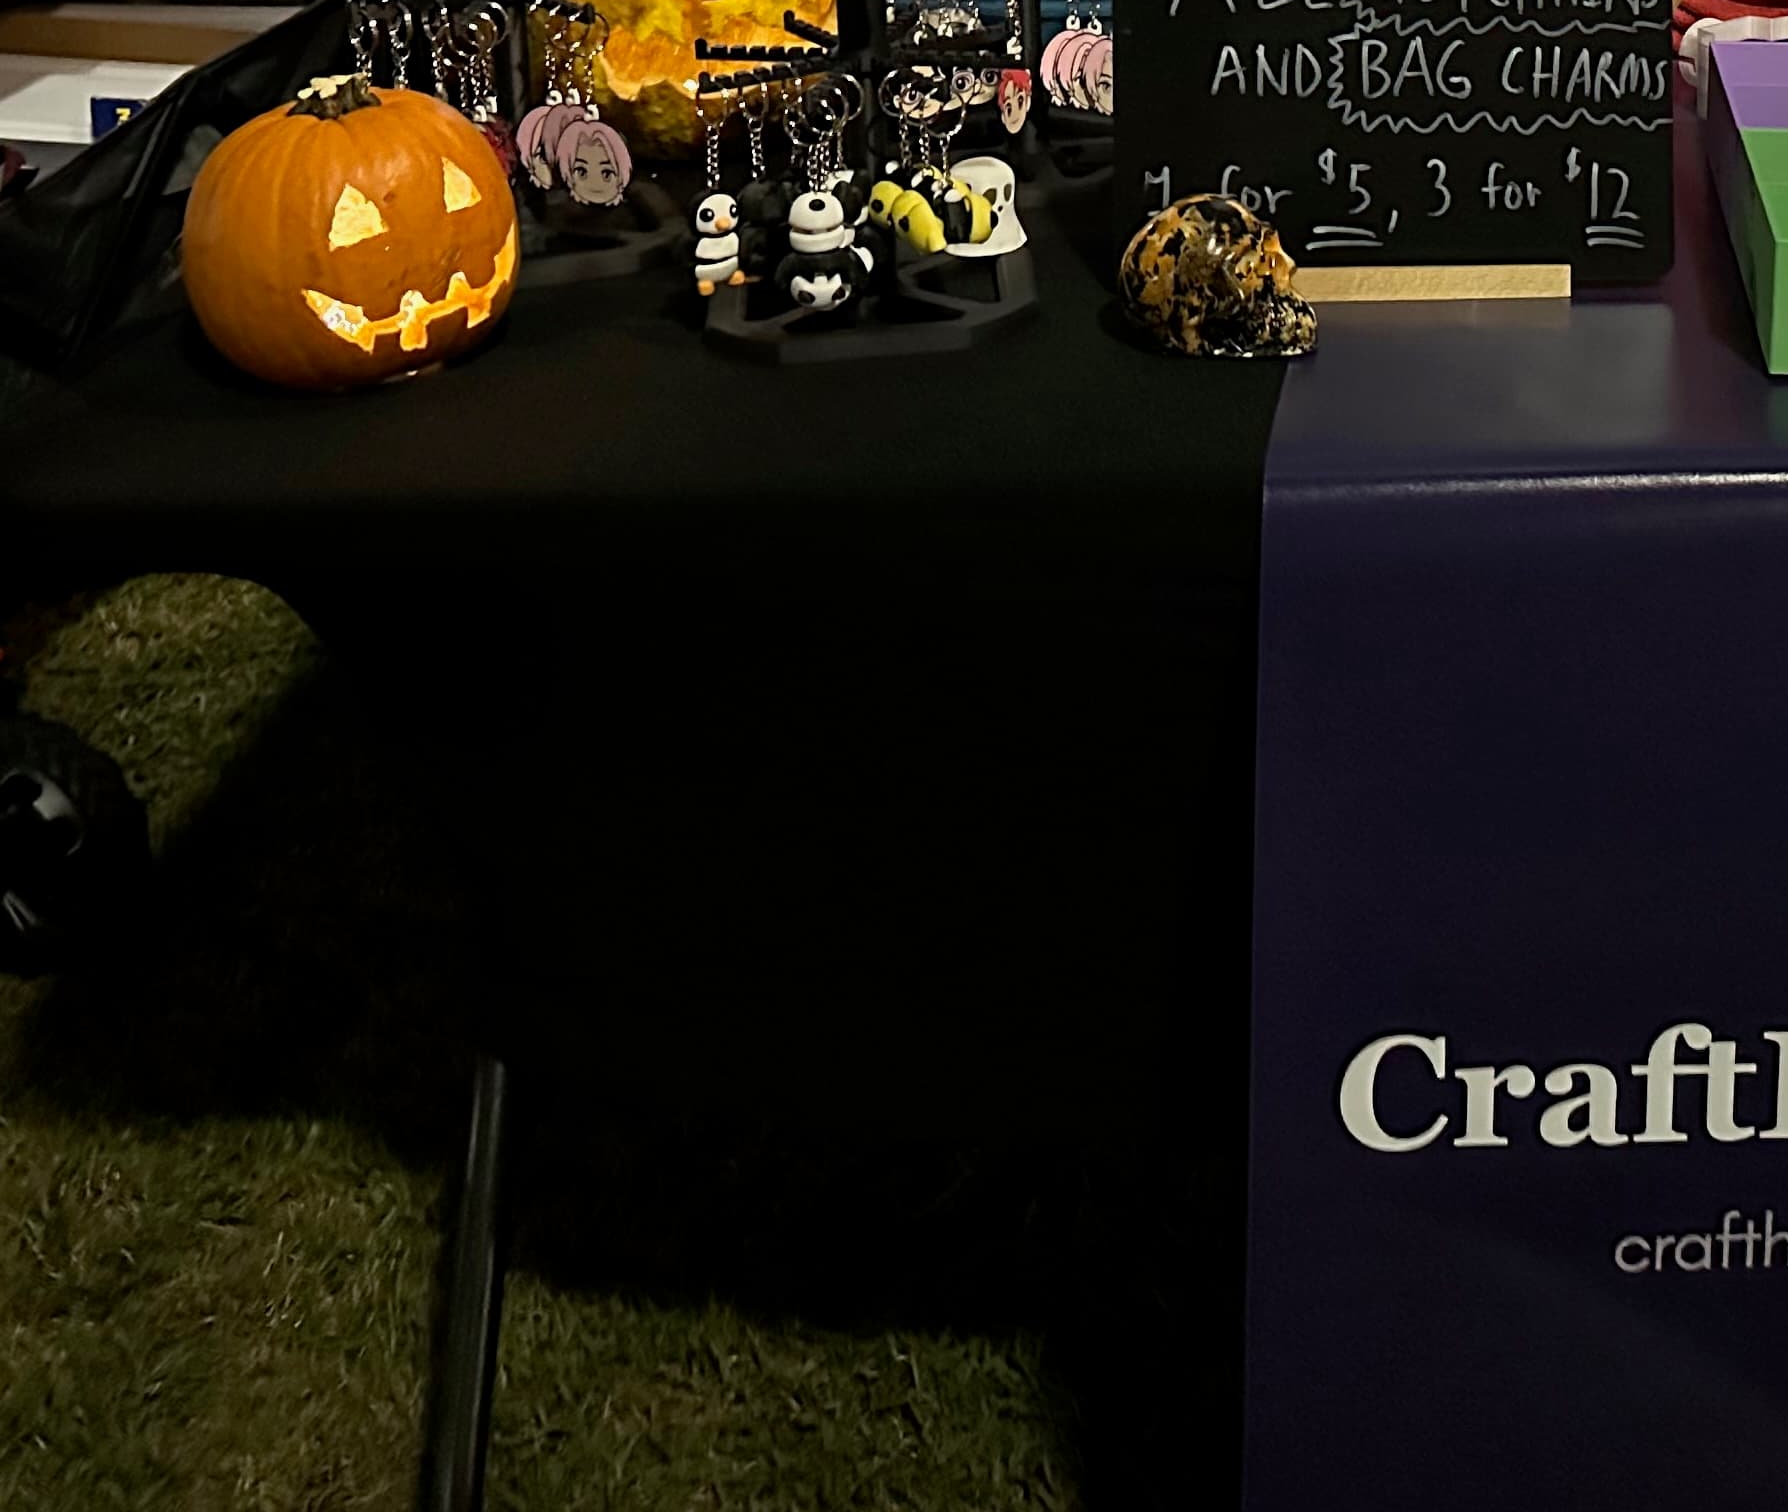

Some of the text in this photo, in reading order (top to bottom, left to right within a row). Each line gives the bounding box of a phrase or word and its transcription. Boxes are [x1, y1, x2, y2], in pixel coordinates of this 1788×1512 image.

[1211, 35, 1667, 101] AND BAG CHARMS
[1220, 164, 1293, 214] for
[1317, 147, 1398, 234] $5,
[1426, 158, 1451, 217] 3
[1480, 162, 1542, 210] for
[1566, 146, 1639, 220] $12
